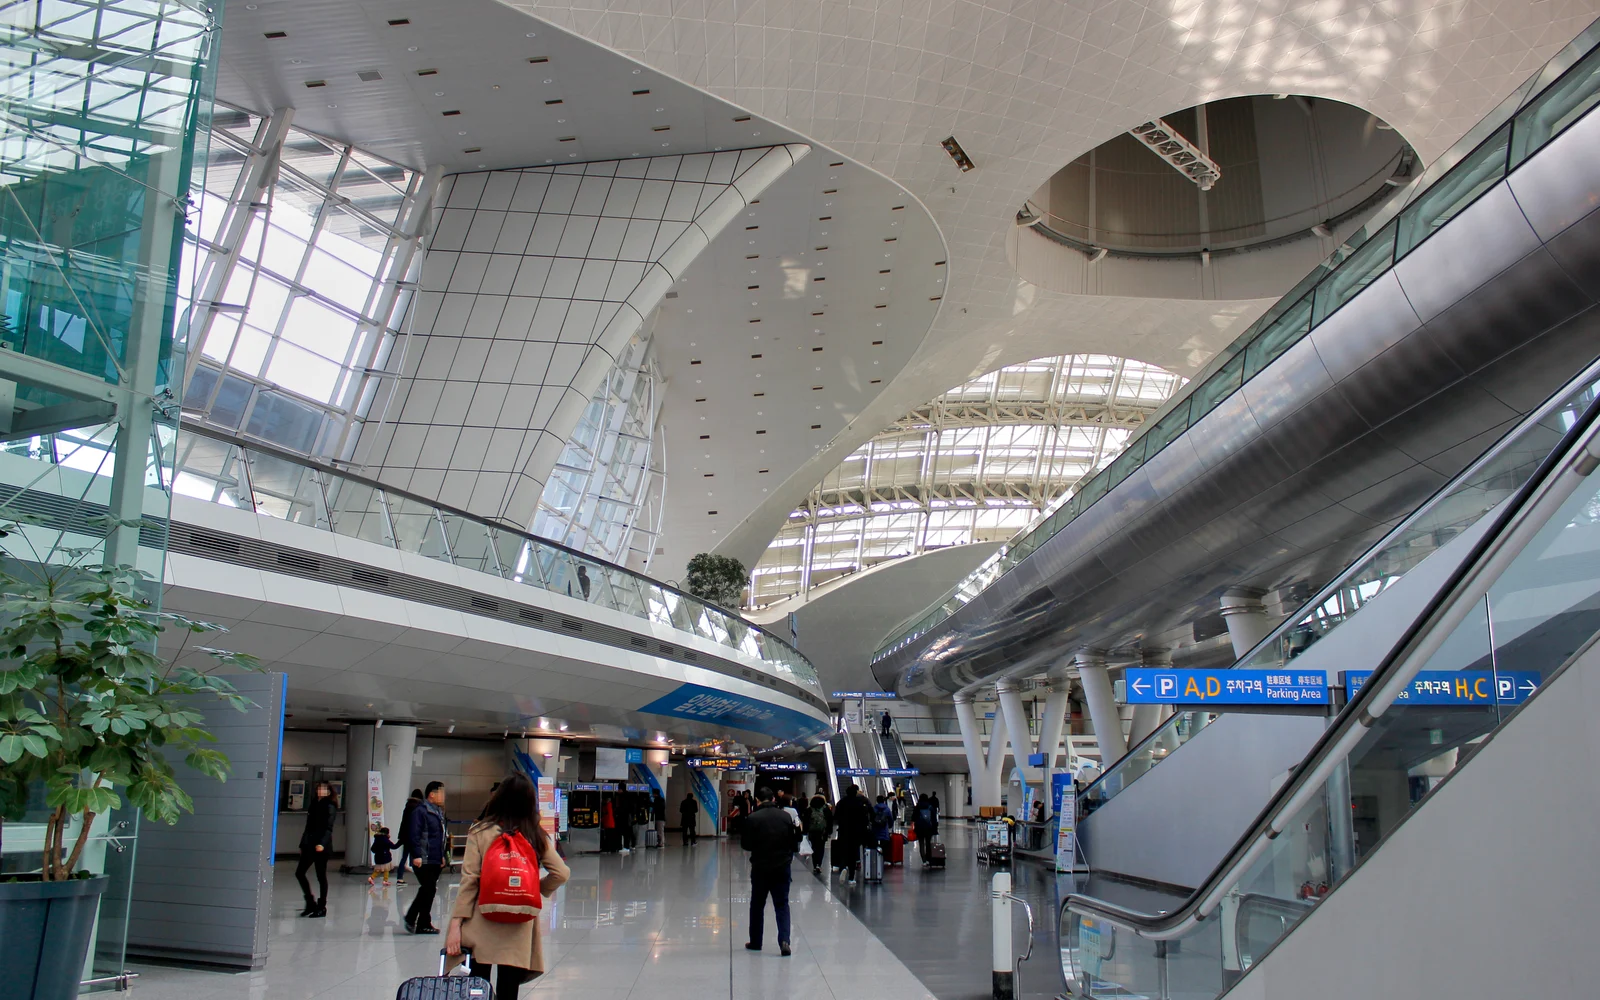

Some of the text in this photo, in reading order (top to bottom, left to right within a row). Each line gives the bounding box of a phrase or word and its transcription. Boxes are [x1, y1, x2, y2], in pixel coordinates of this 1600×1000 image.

[1160, 676, 1221, 700] P A,D
[1226, 679, 1263, 694] 주차구역
[1414, 680, 1451, 695] 주차구역
[1455, 677, 1512, 701] H,C P
[1267, 688, 1321, 701] Parking Area
